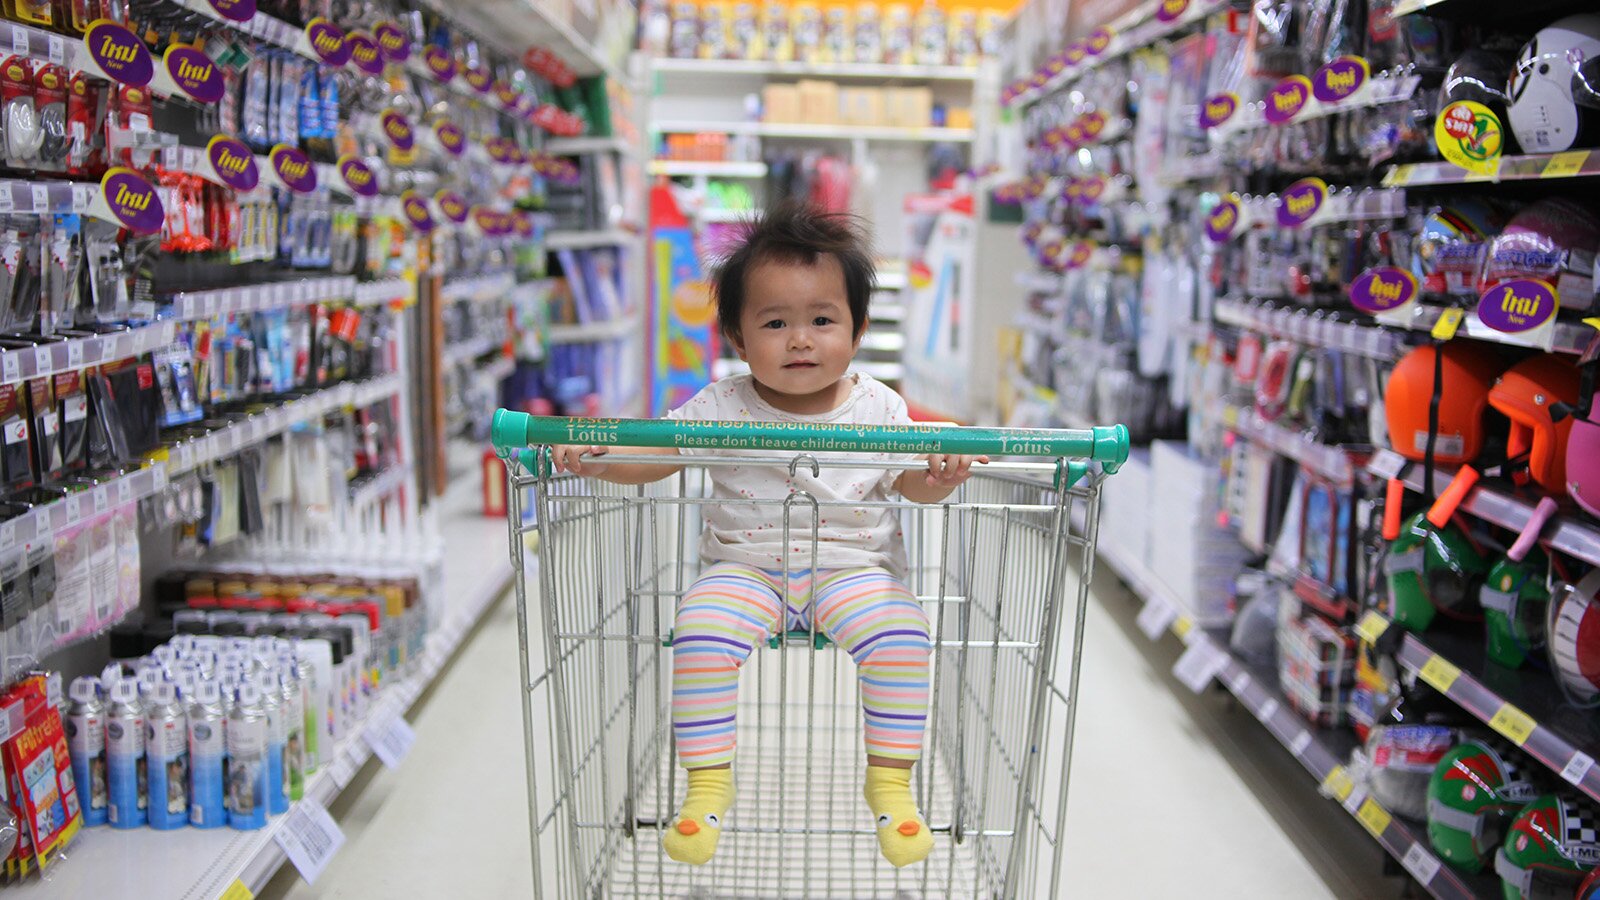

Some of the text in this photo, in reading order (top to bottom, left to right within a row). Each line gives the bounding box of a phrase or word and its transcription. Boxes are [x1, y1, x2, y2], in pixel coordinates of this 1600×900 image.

[99, 35, 140, 63] ใหม่
[106, 59, 124, 70] New
[177, 57, 213, 82] ใหม่
[114, 183, 153, 211] ใหม่
[119, 206, 137, 217] New
[1501, 286, 1541, 317] ใหม่
[1508, 313, 1526, 325] New
[568, 428, 618, 443] Lotus
[674, 433, 942, 452] Please don't leave children unattended
[1001, 436, 1051, 454] Lotus
